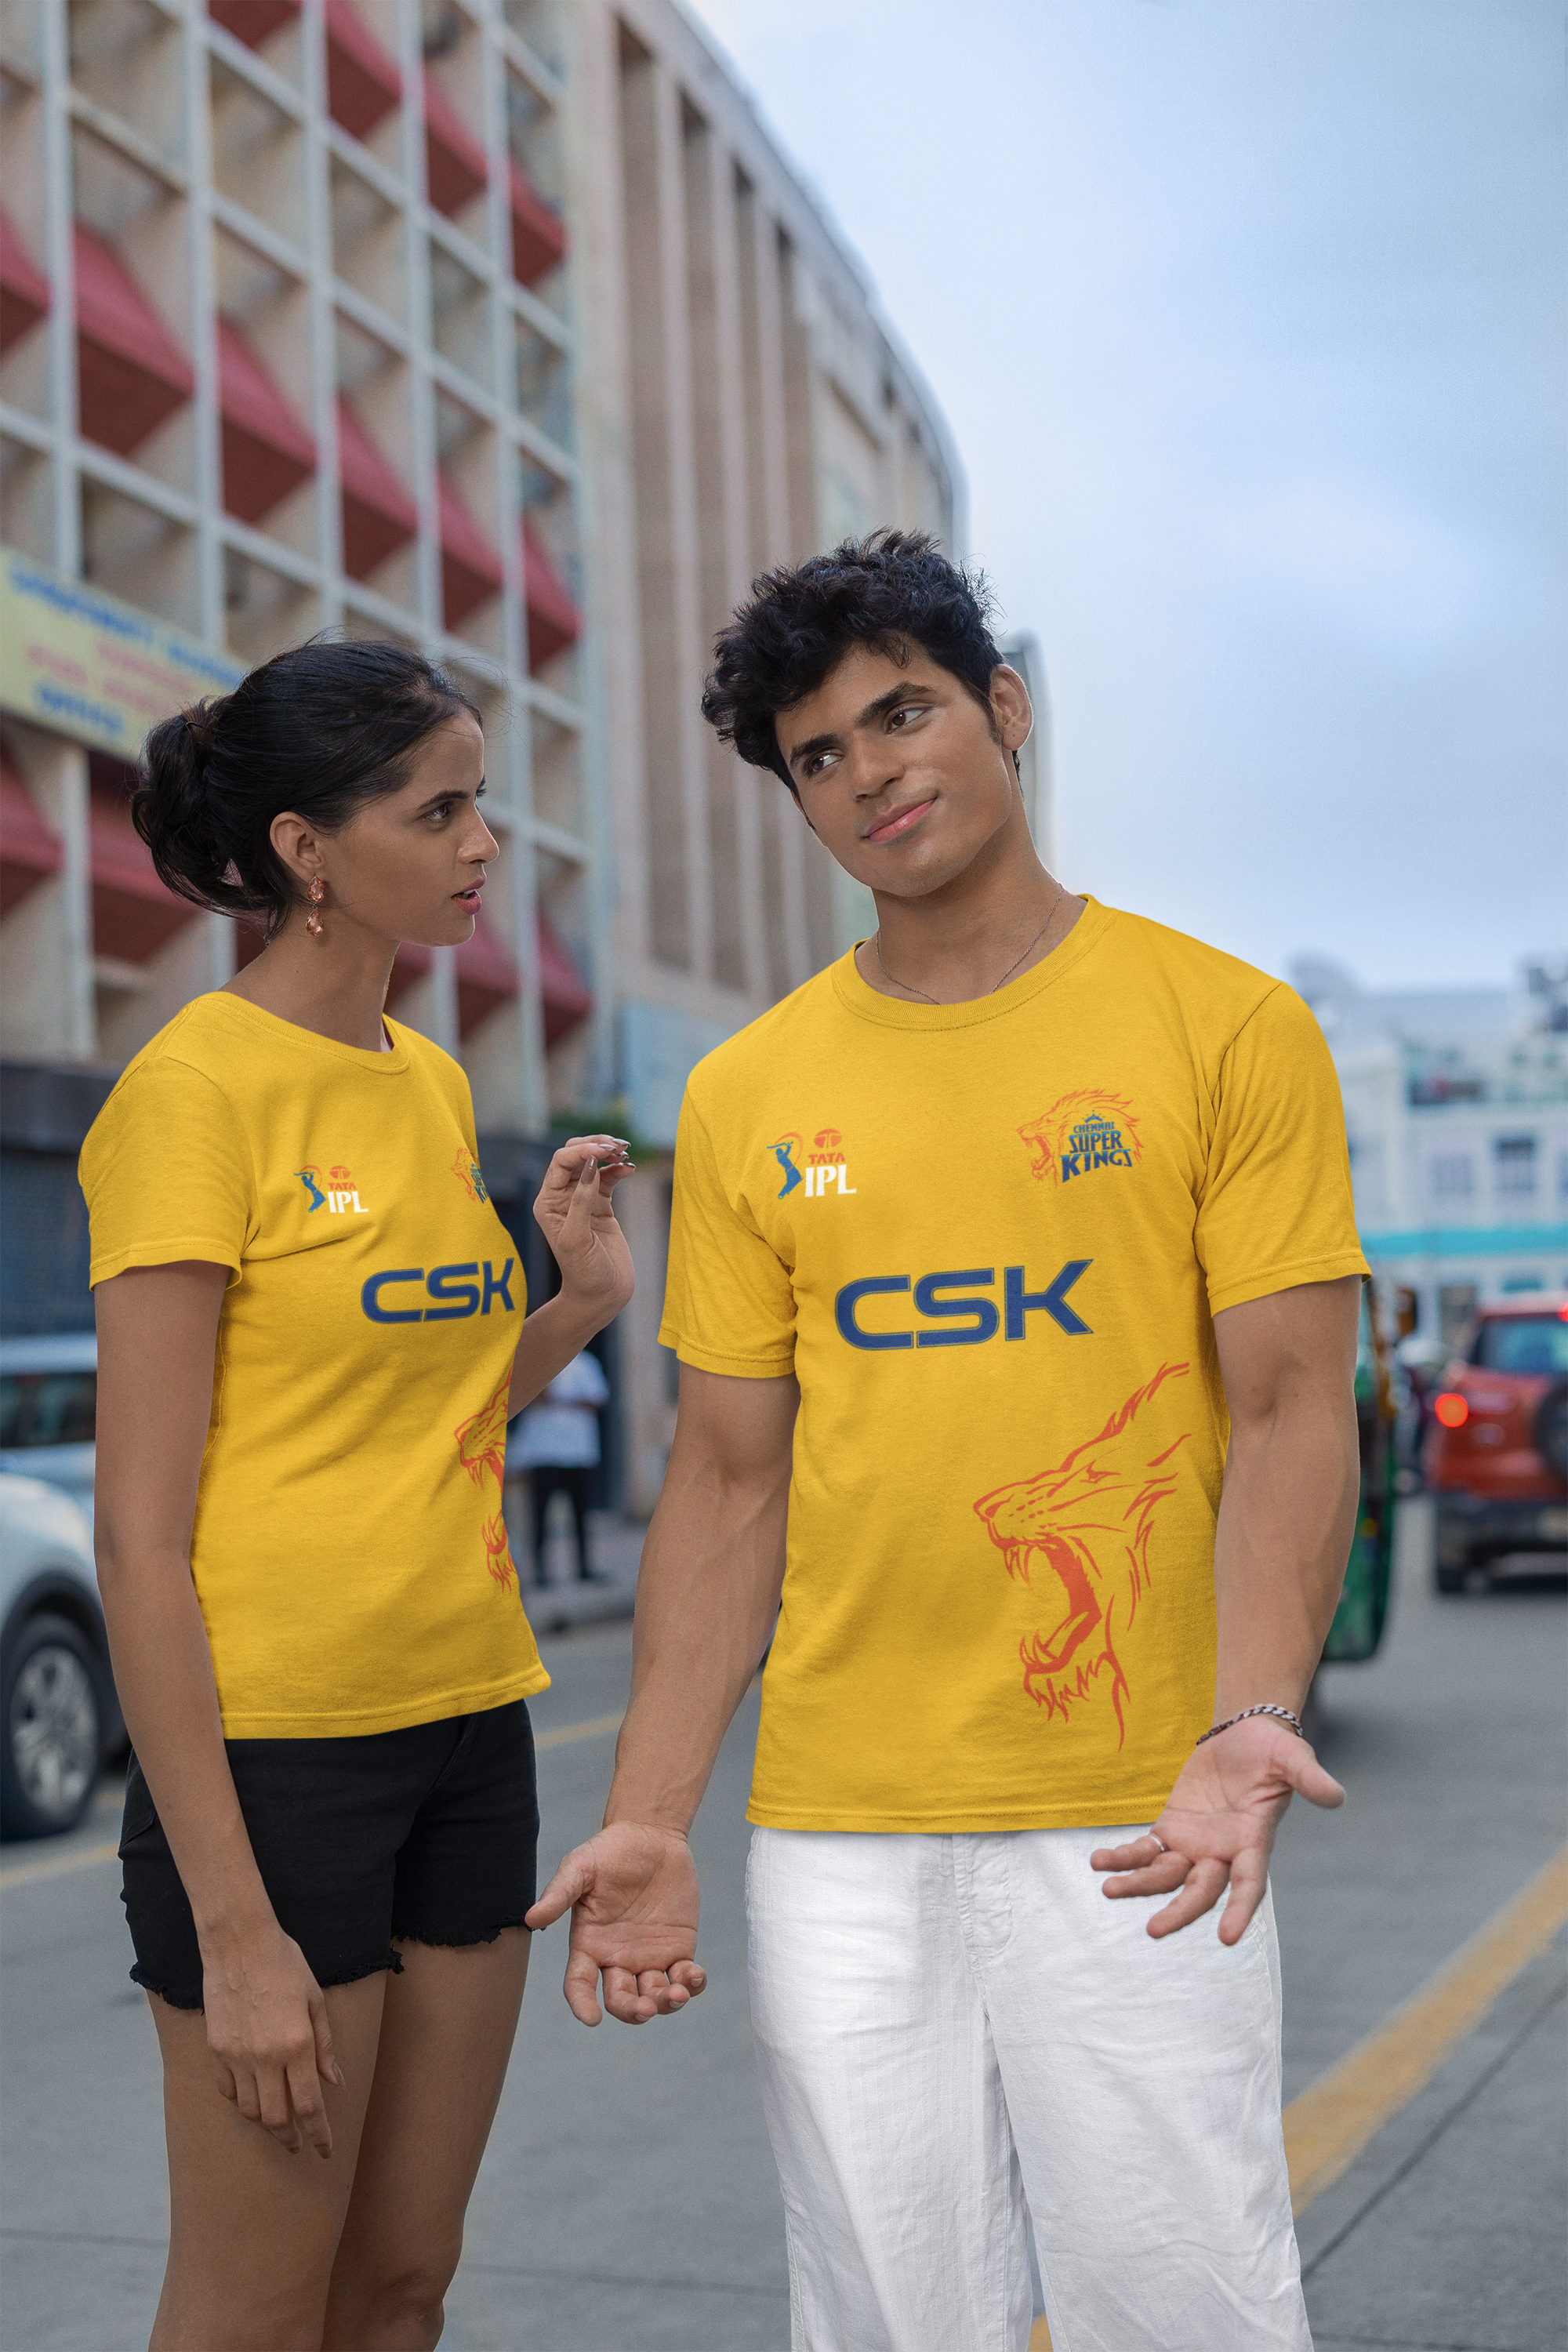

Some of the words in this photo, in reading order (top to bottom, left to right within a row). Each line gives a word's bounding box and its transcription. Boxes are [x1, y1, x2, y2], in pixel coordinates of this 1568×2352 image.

[1073, 1121, 1115, 1134] CHENNAI
[1069, 1130, 1123, 1154] SUPER
[808, 1151, 846, 1165] TATA
[1060, 1149, 1133, 1183] KINGS
[328, 1181, 357, 1190] TATA
[804, 1164, 857, 1197] IPL
[327, 1191, 369, 1214] IPL
[361, 1258, 515, 1324] CSK
[834, 1258, 1094, 1352] CSK
